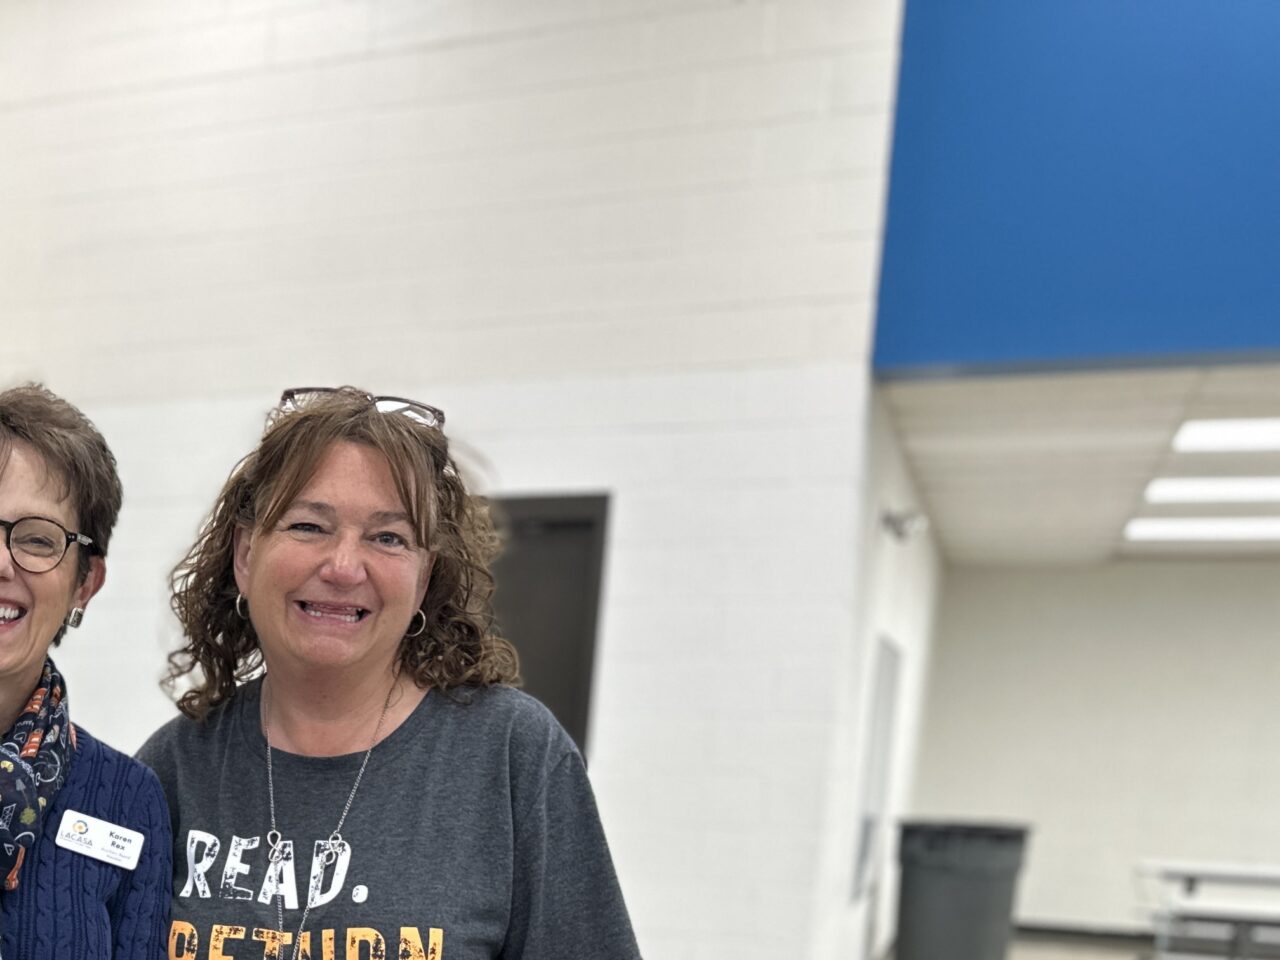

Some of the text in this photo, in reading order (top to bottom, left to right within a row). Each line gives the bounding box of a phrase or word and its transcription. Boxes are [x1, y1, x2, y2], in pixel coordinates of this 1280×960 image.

[60, 830, 93, 846] LACASA
[109, 830, 132, 844] Karen
[111, 841, 125, 850] Rex
[179, 829, 369, 909] READ.
